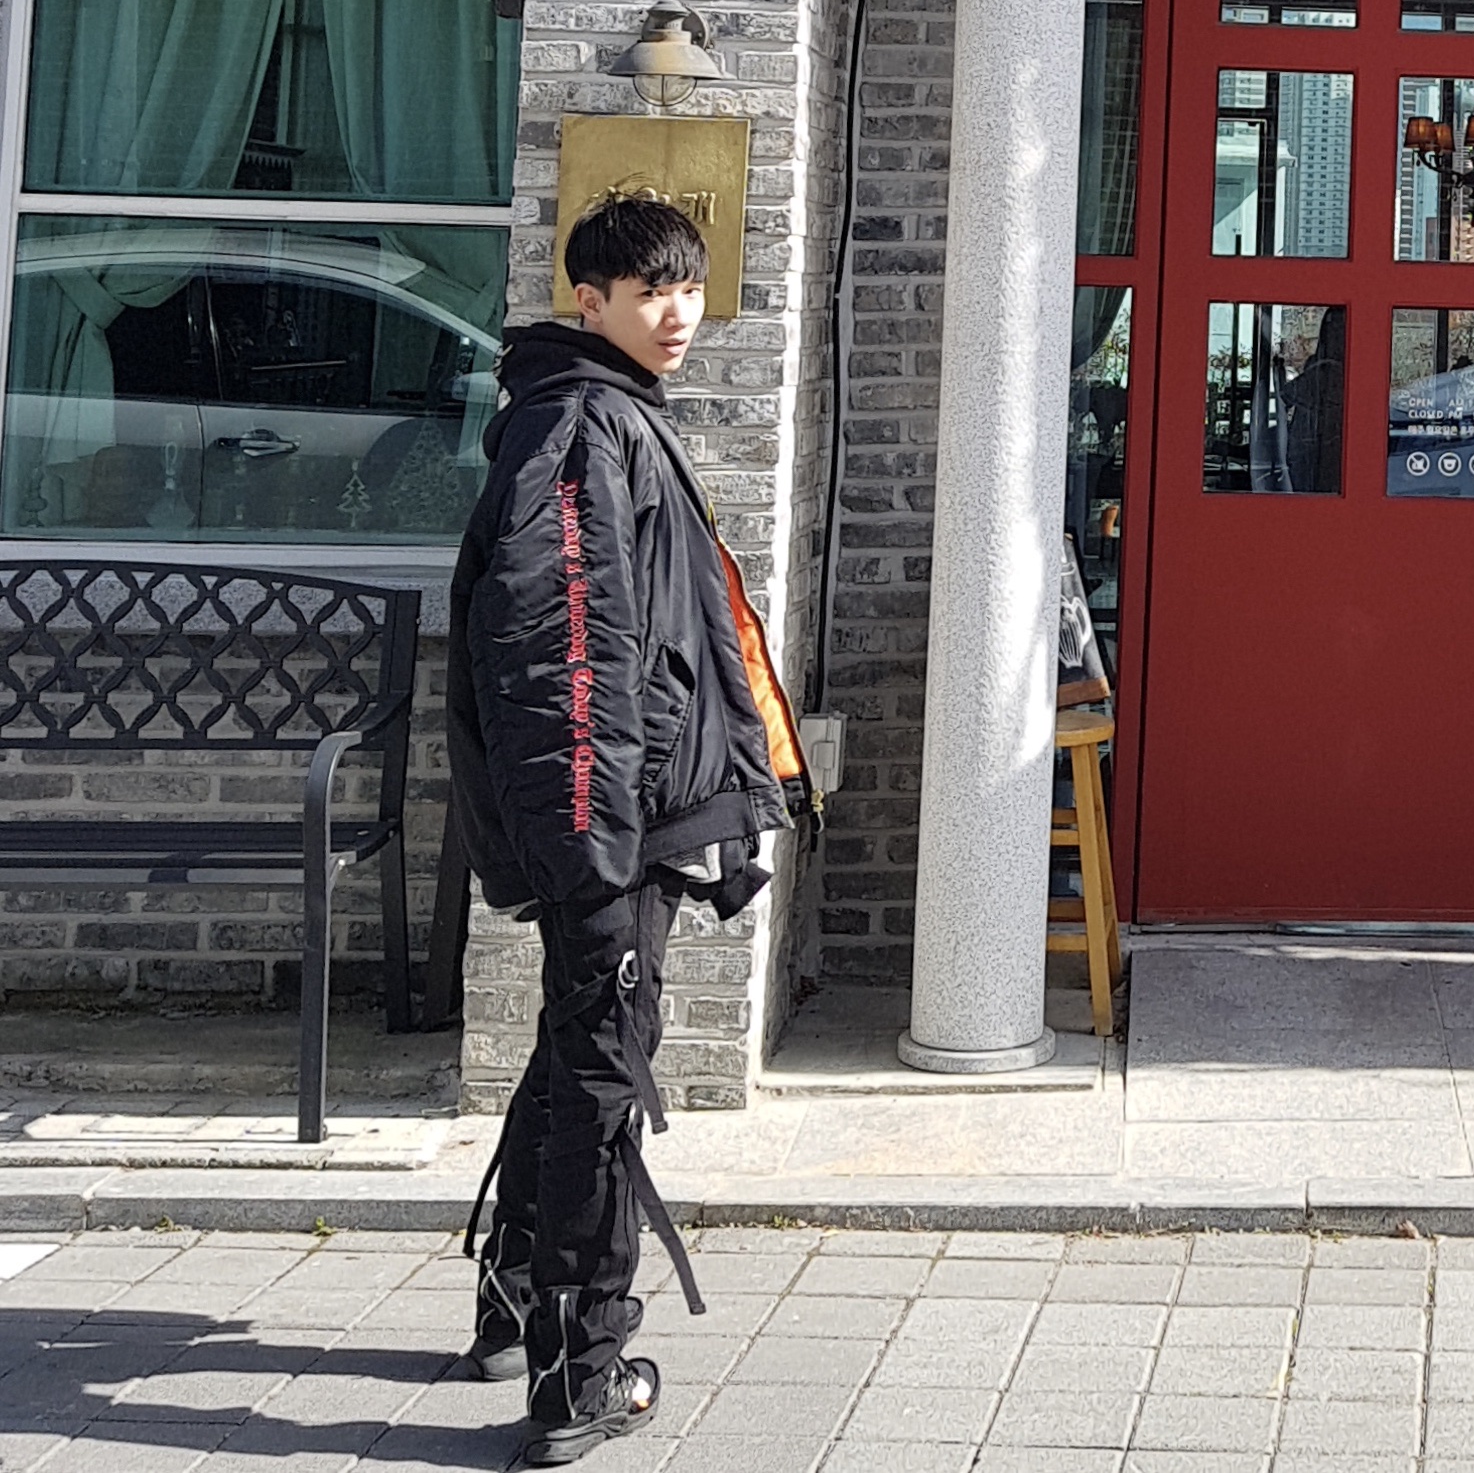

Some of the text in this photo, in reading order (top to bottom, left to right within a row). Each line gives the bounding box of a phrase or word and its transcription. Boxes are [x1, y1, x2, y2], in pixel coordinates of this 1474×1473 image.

[1408, 398, 1434, 408] OPEN
[1448, 398, 1464, 408] AM
[1408, 410, 1444, 420] CLOSED
[1448, 410, 1464, 420] PM
[571, 744, 596, 833] Champion
